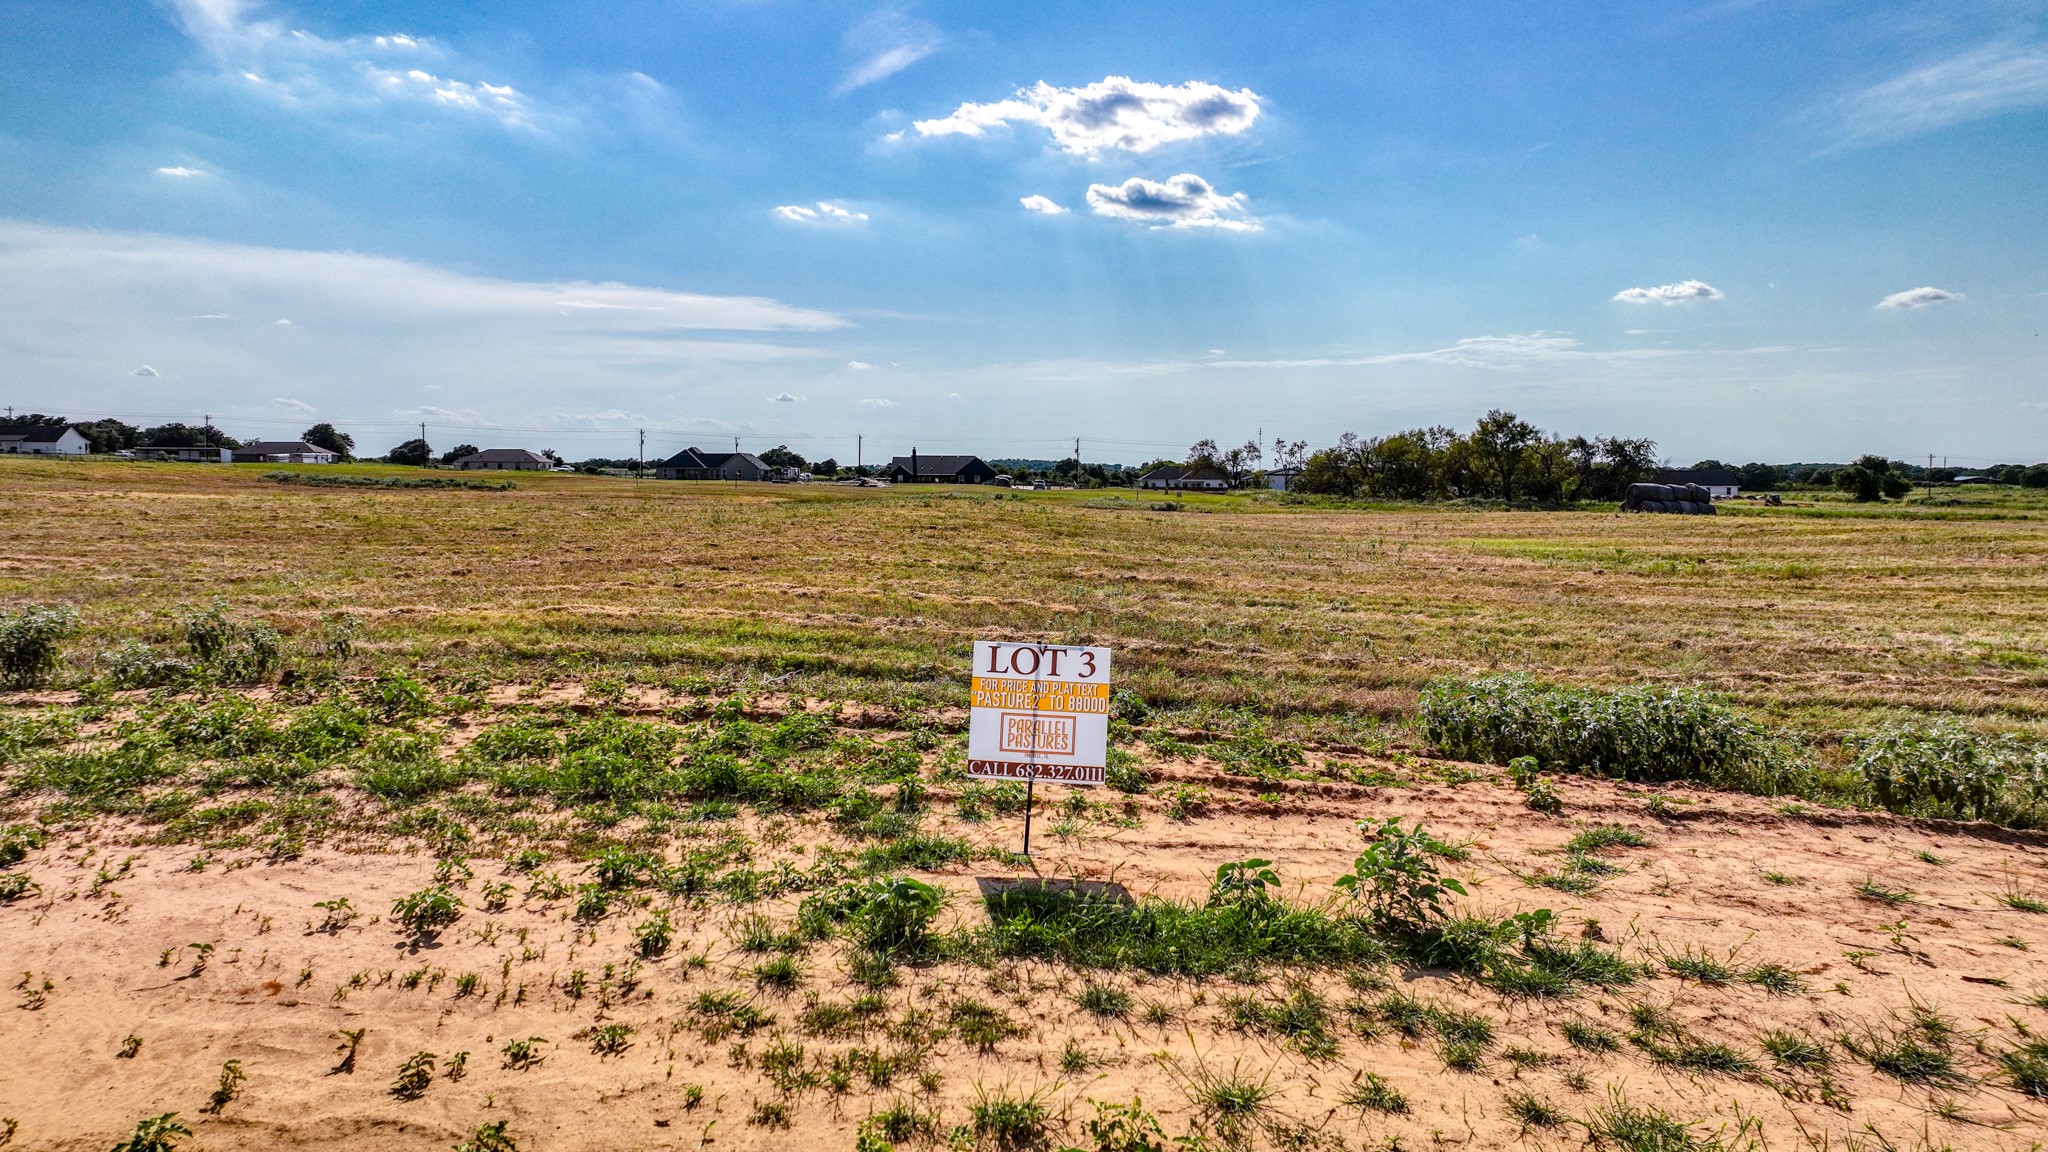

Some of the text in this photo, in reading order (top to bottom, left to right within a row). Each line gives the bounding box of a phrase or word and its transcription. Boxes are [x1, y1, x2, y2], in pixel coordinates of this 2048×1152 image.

[987, 645, 1096, 678] LOT 3
[980, 679, 1099, 696] FOR PRICE AND PLAT TEXT
[1050, 695, 1065, 711] TO
[1068, 697, 1107, 713] 88000
[1008, 718, 1068, 736] PARALLEL
[1007, 733, 1069, 750] PASTURES
[969, 760, 1104, 782] CALL 682.327.0111
